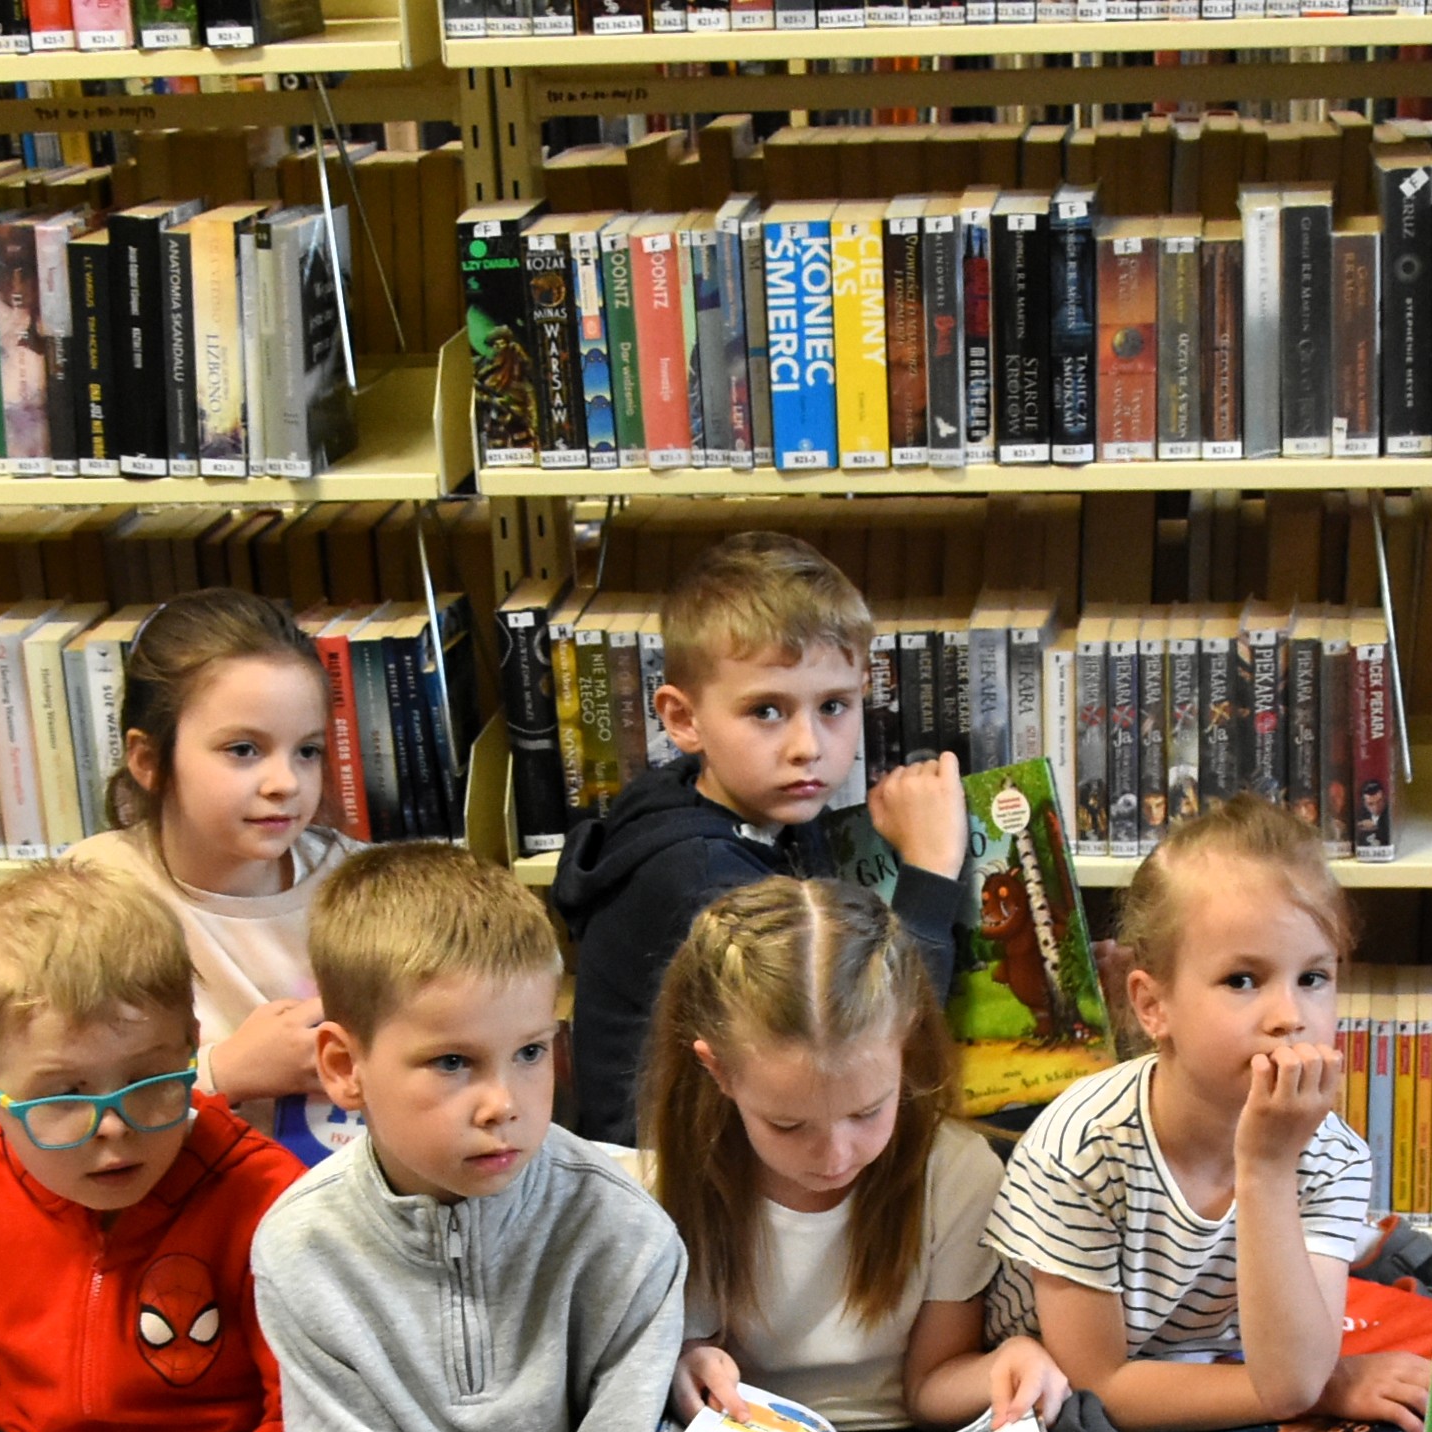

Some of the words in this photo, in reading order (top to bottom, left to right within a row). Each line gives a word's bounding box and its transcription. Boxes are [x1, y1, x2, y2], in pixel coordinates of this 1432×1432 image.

[168, 239, 183, 310] ANATOMIA
[831, 235, 858, 298] LAS
[859, 233, 887, 367] CIEMNY
[172, 312, 185, 383] SKANDALU
[533, 308, 568, 319] MINAS
[765, 238, 801, 391] ŚMIERCI
[801, 237, 835, 387] KONIEC
[543, 323, 568, 424] WARSAW
[1024, 356, 1039, 430] STARCIE
[1063, 356, 1075, 428] SMOKAMI
[1076, 353, 1088, 410] TANIEC
[592, 653, 607, 676] NIE
[595, 678, 609, 699] MA
[1255, 648, 1275, 714] PIEKARA
[102, 685, 113, 708] SUE
[108, 711, 121, 768] WATSON
[579, 676, 595, 725] ZŁEGO
[599, 701, 612, 742] TEGO
[1371, 690, 1385, 740] PIEKARA
[565, 728, 581, 808] NONSTEAD
